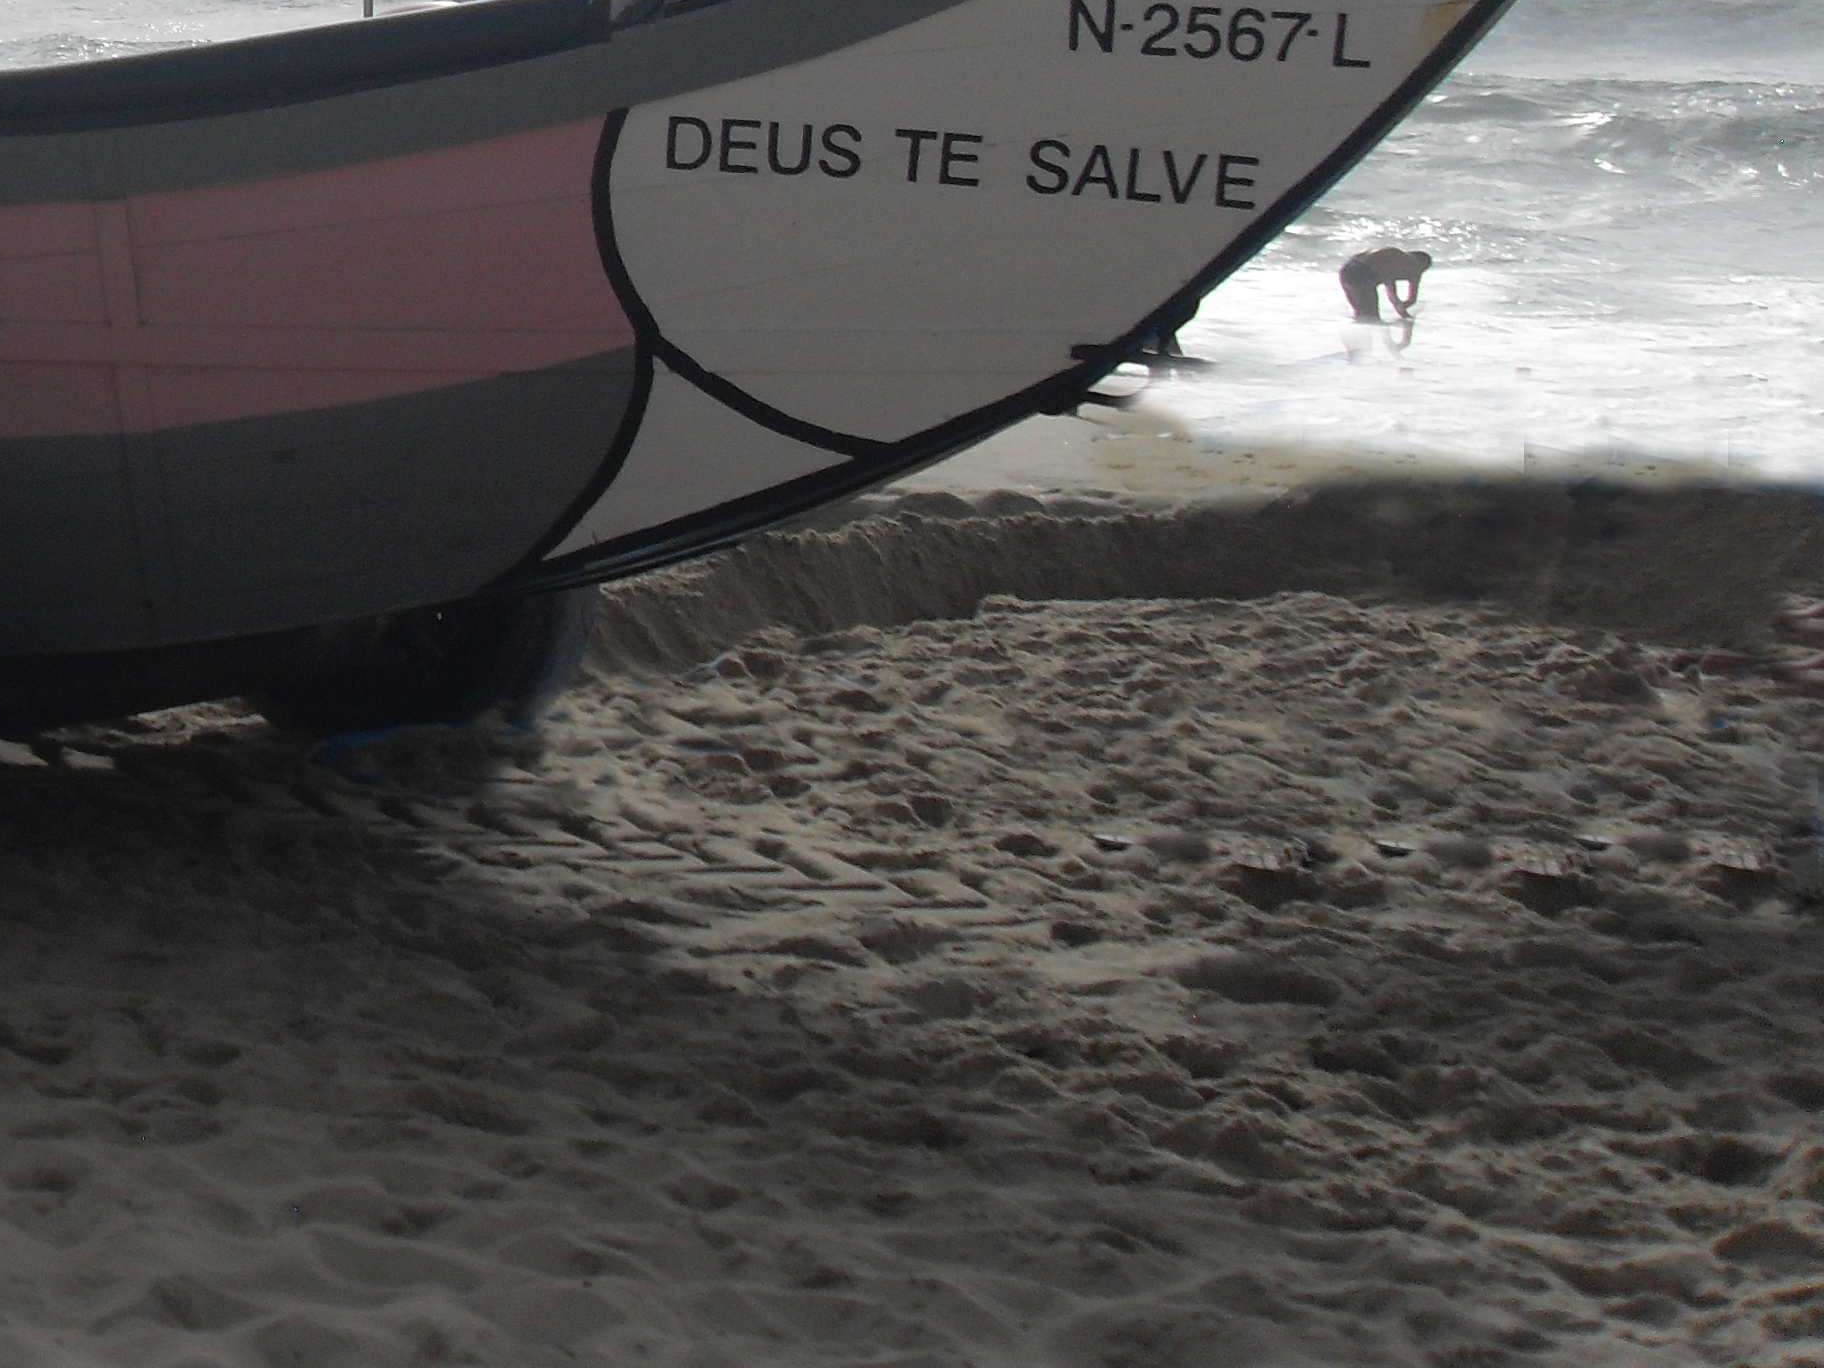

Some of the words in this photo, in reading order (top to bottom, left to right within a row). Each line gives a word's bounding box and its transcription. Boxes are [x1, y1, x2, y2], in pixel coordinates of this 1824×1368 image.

[666, 115, 863, 179] DEUS
[894, 128, 984, 188] TE
[1025, 138, 1260, 211] SALVE
